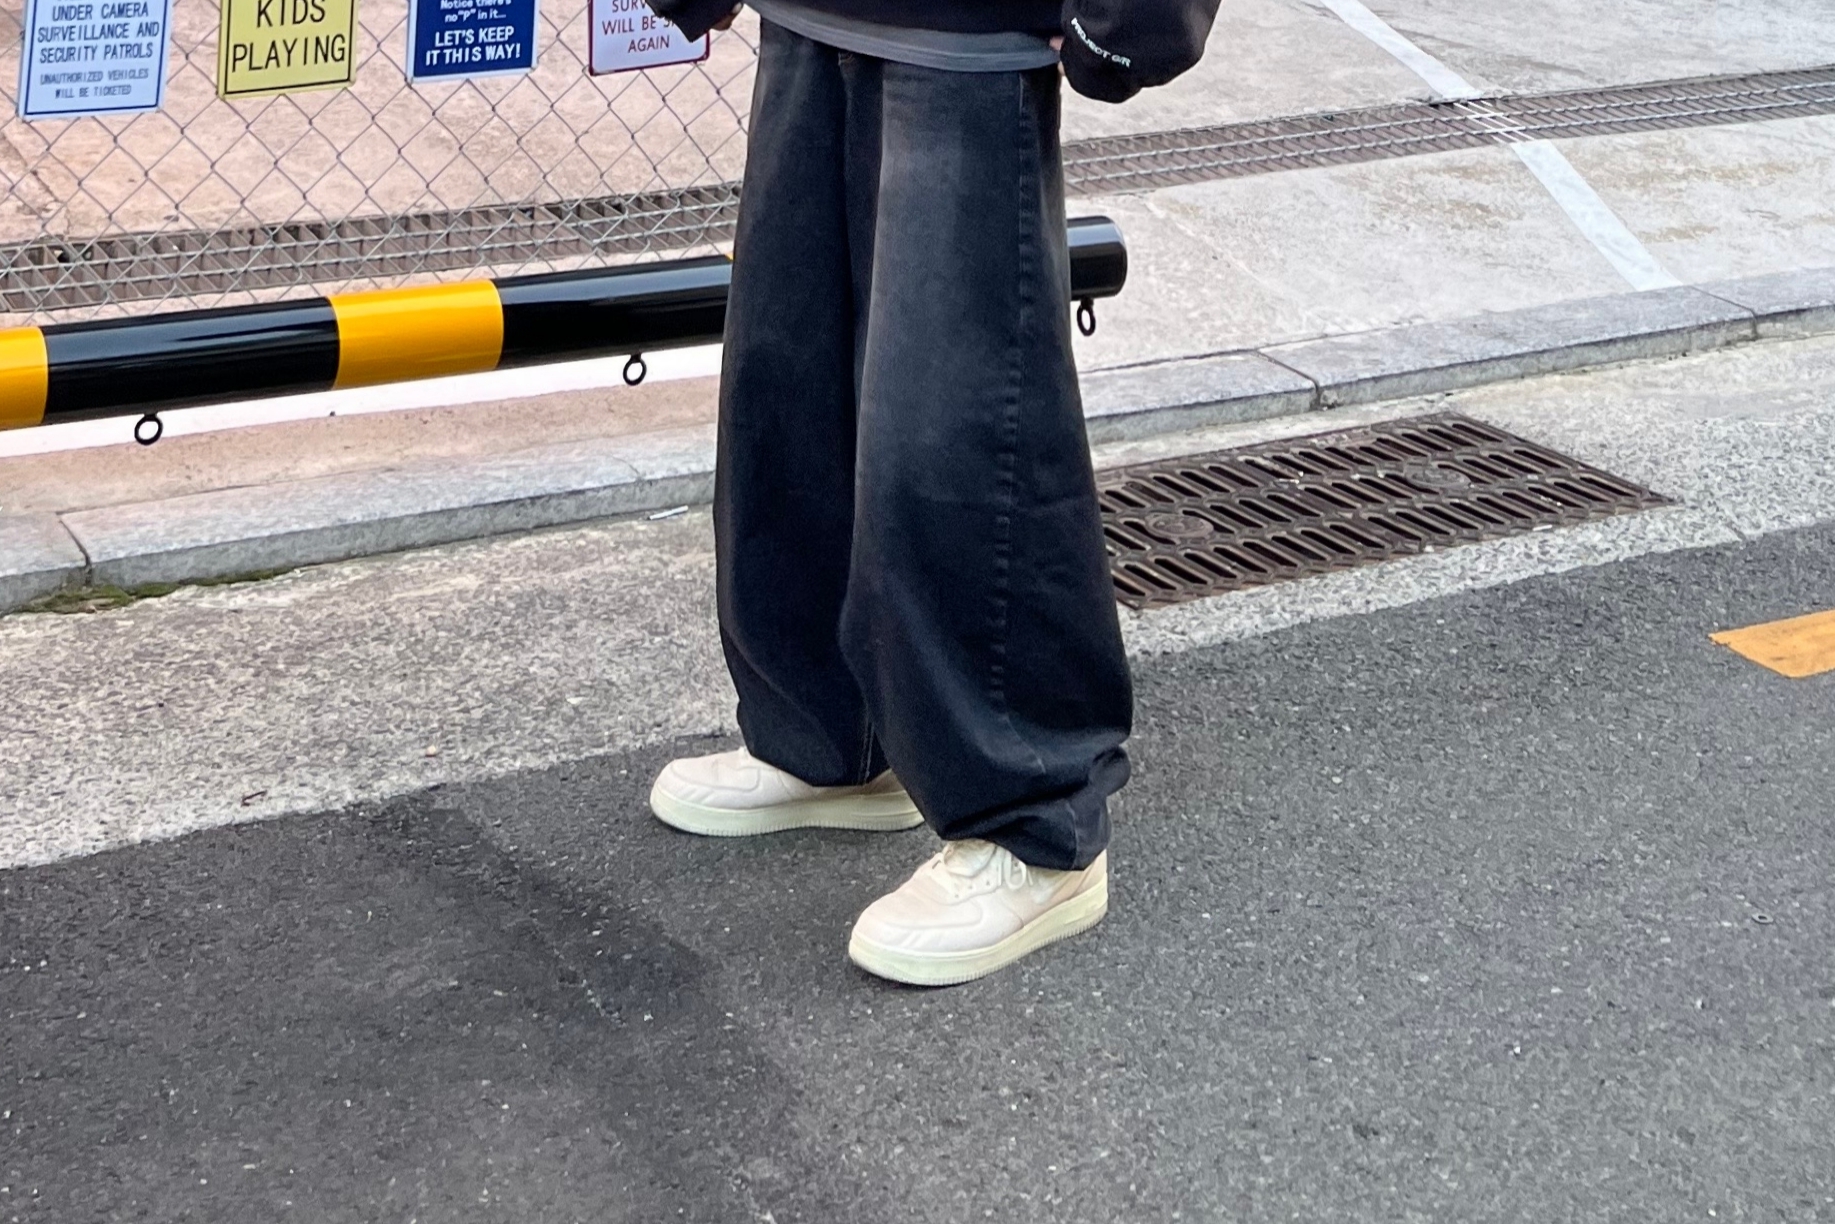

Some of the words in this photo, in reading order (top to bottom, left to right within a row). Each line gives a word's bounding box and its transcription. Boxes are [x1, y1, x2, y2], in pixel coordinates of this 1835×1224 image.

[52, 5, 93, 21] UNDER
[101, 1, 149, 18] CAMERA
[445, 14, 458, 23] no
[477, 9, 487, 20] in
[37, 23, 129, 43] SURVEILLANCE
[137, 21, 160, 37] AND
[602, 19, 634, 35] WILL
[642, 16, 656, 30] BE
[435, 29, 474, 47] LET'S
[479, 26, 514, 43] KEEP
[627, 35, 670, 53] AGAIN
[40, 45, 98, 64] SECURITY
[103, 42, 153, 60] PATROLS
[232, 34, 346, 73] PLAYING
[426, 50, 440, 66] IT
[443, 46, 482, 63] THIS
[486, 44, 521, 61] WAY!
[40, 71, 103, 85] UNAUTHORIZED
[108, 69, 149, 80] VEHICLES
[55, 88, 74, 98] WILL
[80, 87, 90, 97] BE
[94, 85, 131, 96] TICKETED
